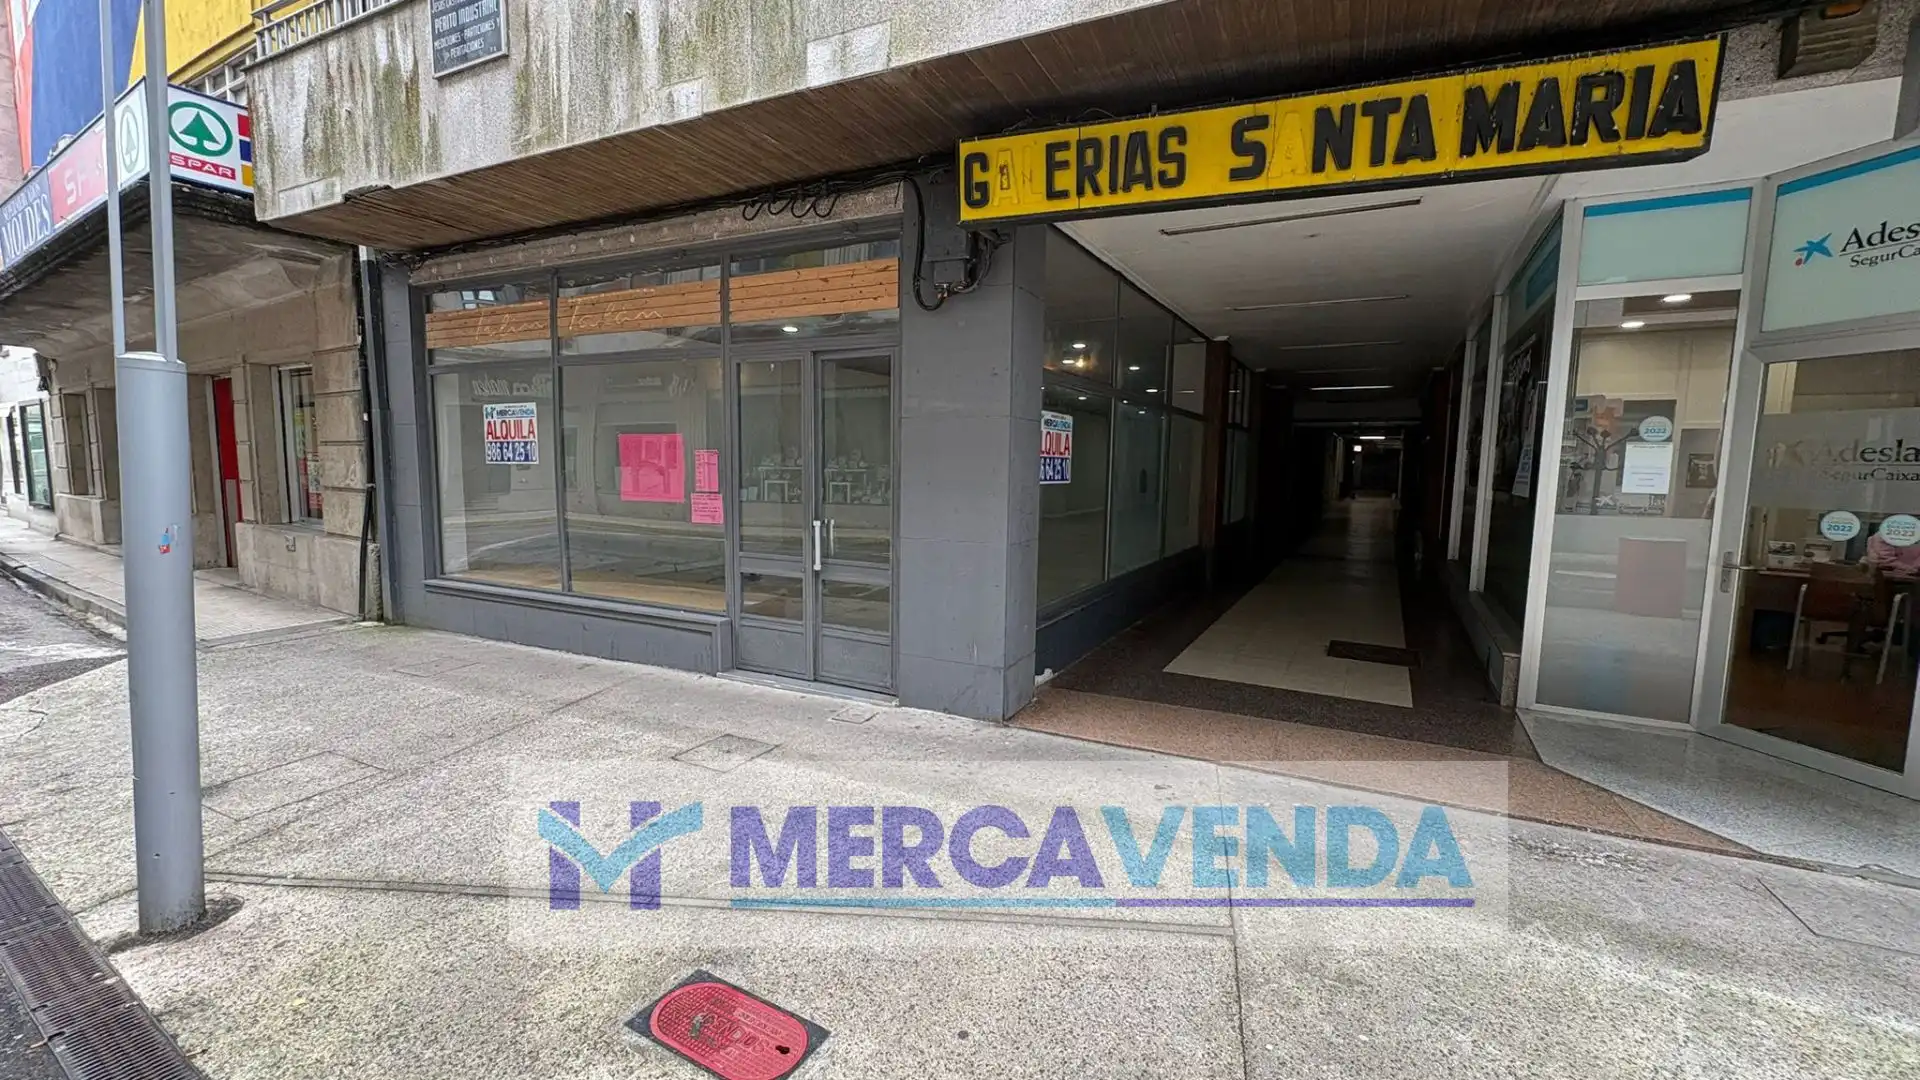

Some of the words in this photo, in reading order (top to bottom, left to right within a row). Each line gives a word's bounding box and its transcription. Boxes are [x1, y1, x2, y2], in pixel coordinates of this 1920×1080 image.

[434, 12, 457, 34] PERITO
[434, 32, 461, 50] MEDICIONES
[450, 37, 485, 59] PERITACIONES
[1459, 60, 1702, 157] MARIA
[170, 153, 235, 181] SPAR
[496, 408, 535, 417] MERCAVENDA
[486, 419, 536, 440] ALQUILA
[487, 442, 502, 461] 986
[503, 442, 513, 461] 64
[515, 442, 525, 461] 25
[527, 442, 537, 461] 10
